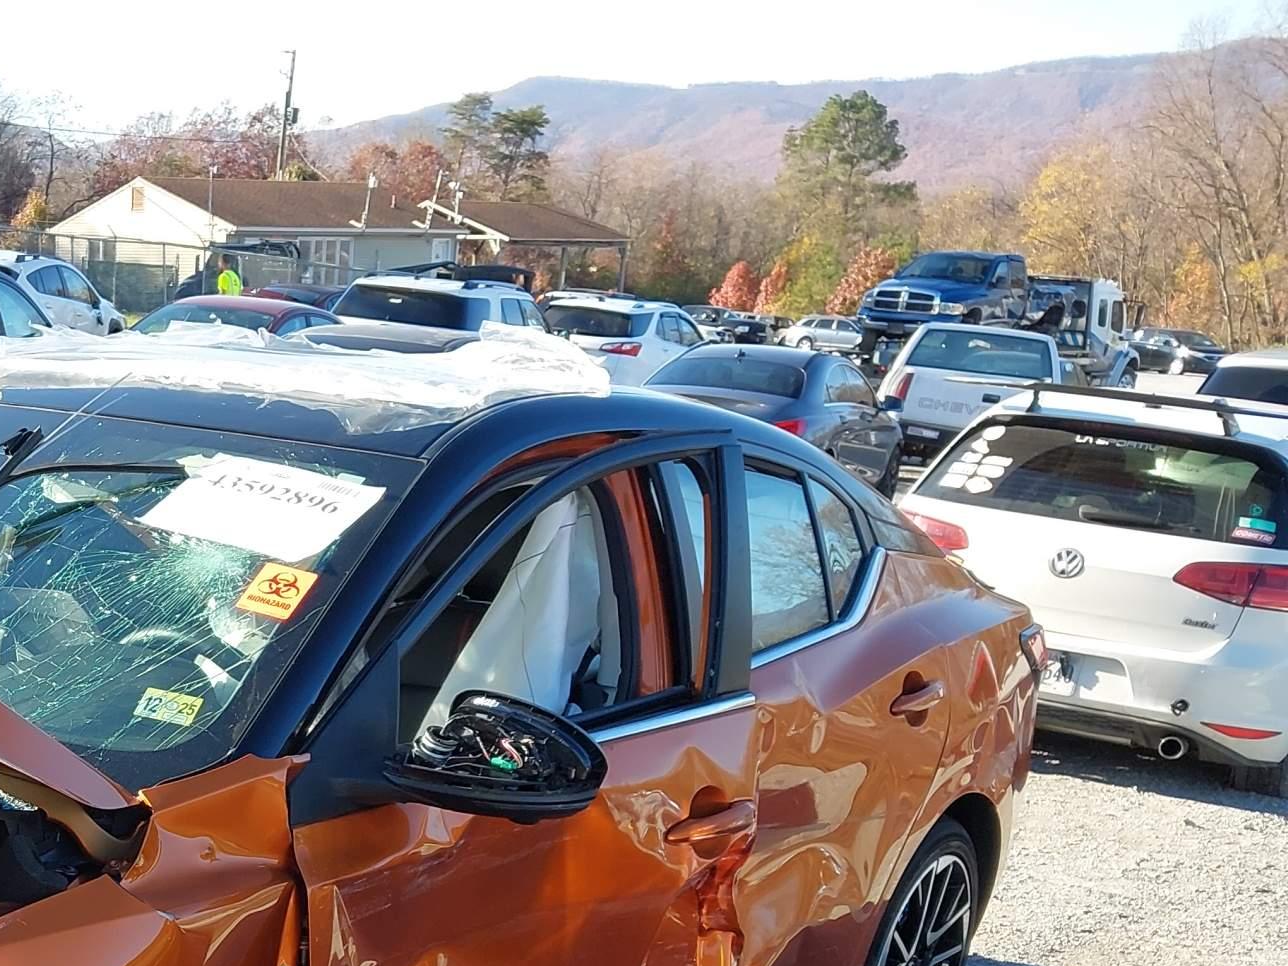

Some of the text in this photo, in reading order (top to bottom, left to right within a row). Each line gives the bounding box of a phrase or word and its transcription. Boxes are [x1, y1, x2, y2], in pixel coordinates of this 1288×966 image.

[918, 397, 980, 416] CHEV
[209, 474, 339, 514] 43592896
[247, 594, 291, 611] BIOHAZARD
[144, 696, 198, 716] 12 25
